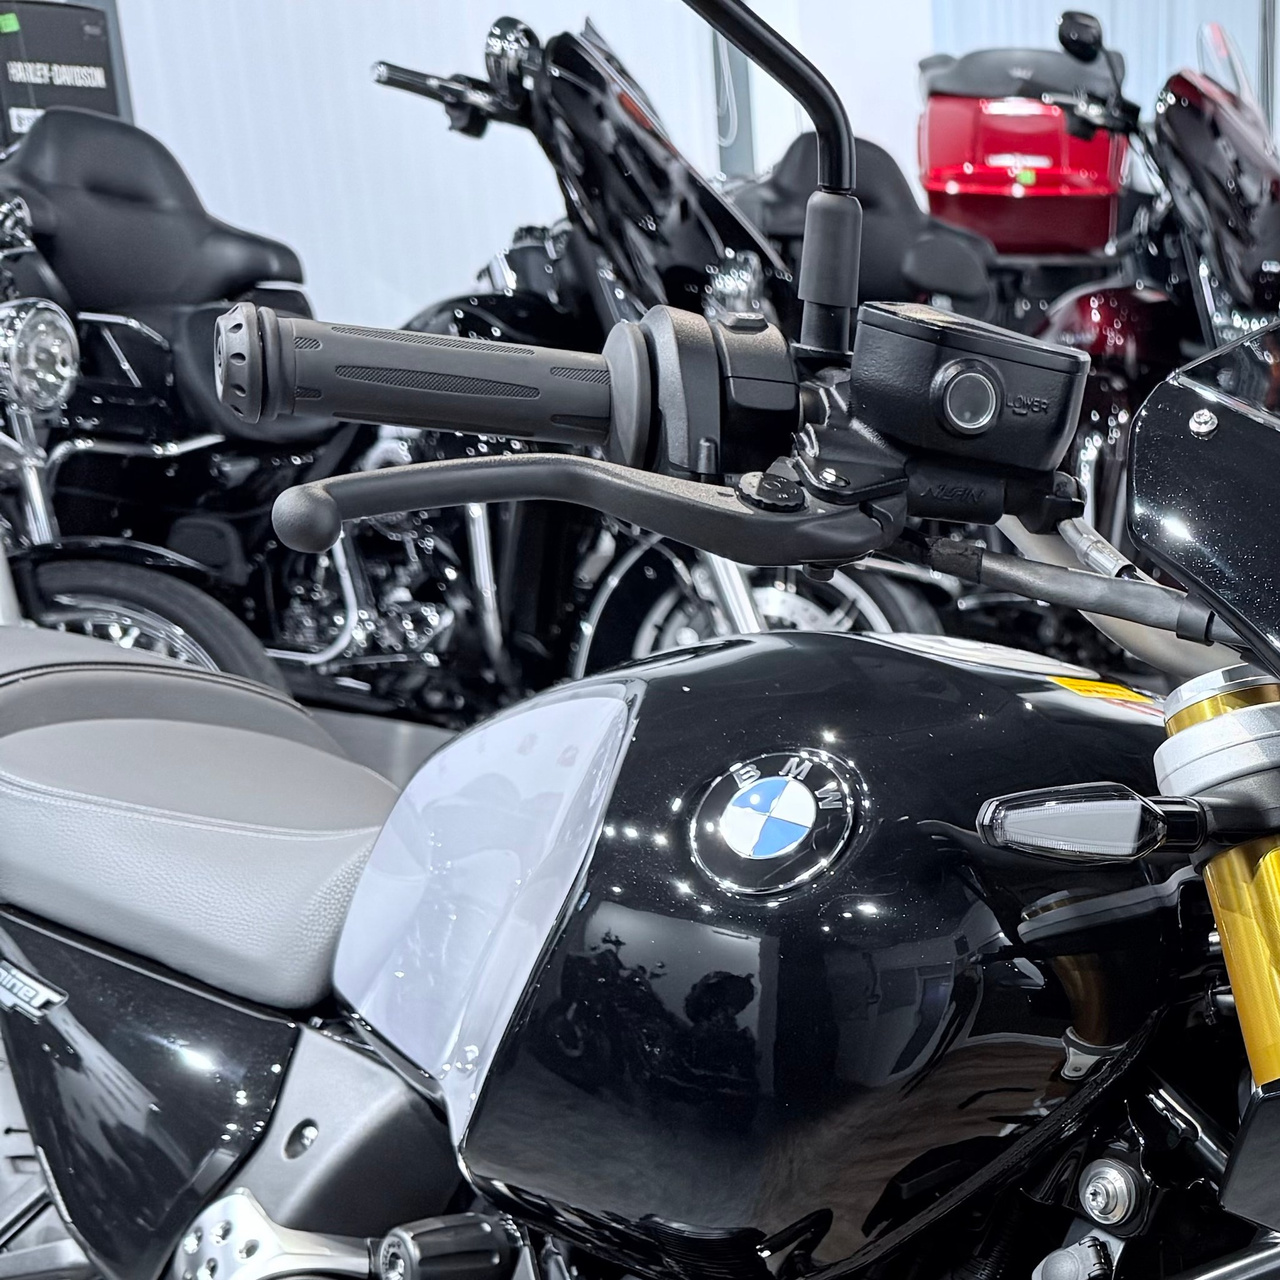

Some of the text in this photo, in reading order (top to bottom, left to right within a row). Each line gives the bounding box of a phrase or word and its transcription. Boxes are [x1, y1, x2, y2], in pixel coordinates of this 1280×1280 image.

[6, 61, 107, 88] HARLEY-DAVIDSON
[1006, 394, 1049, 415] LOWER
[732, 757, 843, 809] BMW
